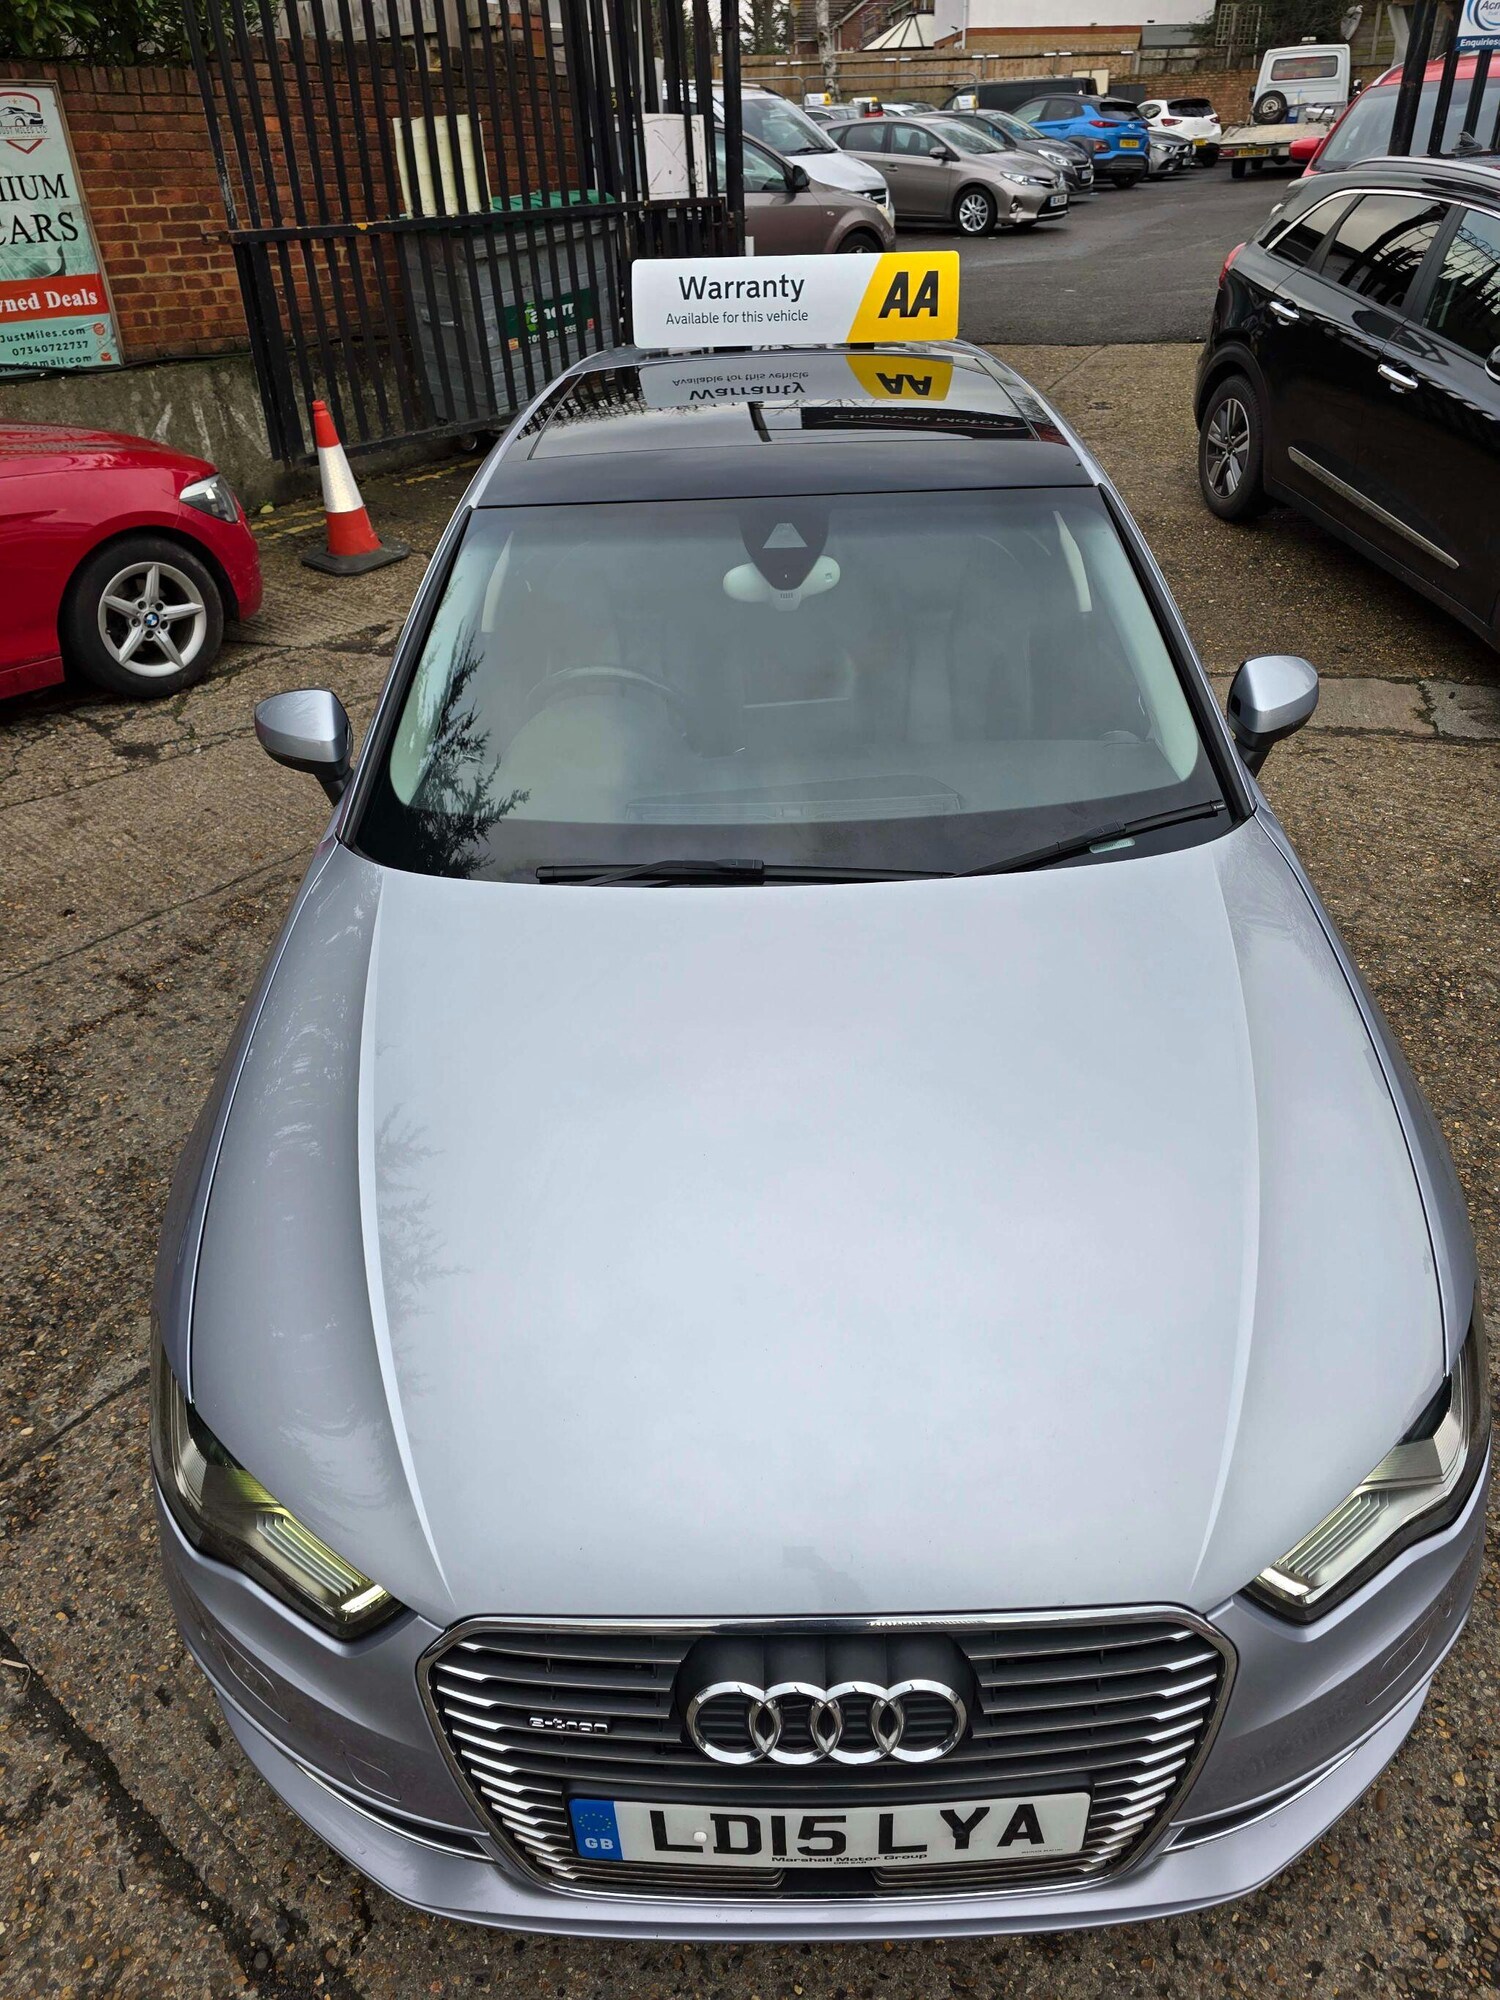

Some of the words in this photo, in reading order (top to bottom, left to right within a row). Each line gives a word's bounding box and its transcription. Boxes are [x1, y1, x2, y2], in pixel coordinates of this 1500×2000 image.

[678, 273, 805, 303] Warranty
[877, 270, 939, 319] AA
[44, 288, 99, 309] Deals
[666, 311, 720, 325] Available
[722, 311, 740, 323] for
[742, 310, 764, 323] this
[766, 309, 809, 322] vehicle
[12, 340, 89, 356] 07340722737
[529, 1716, 608, 1734] e-tron
[650, 1810, 847, 1857] LD15
[878, 1803, 1045, 1855] LYA
[584, 1837, 613, 1850] GB
